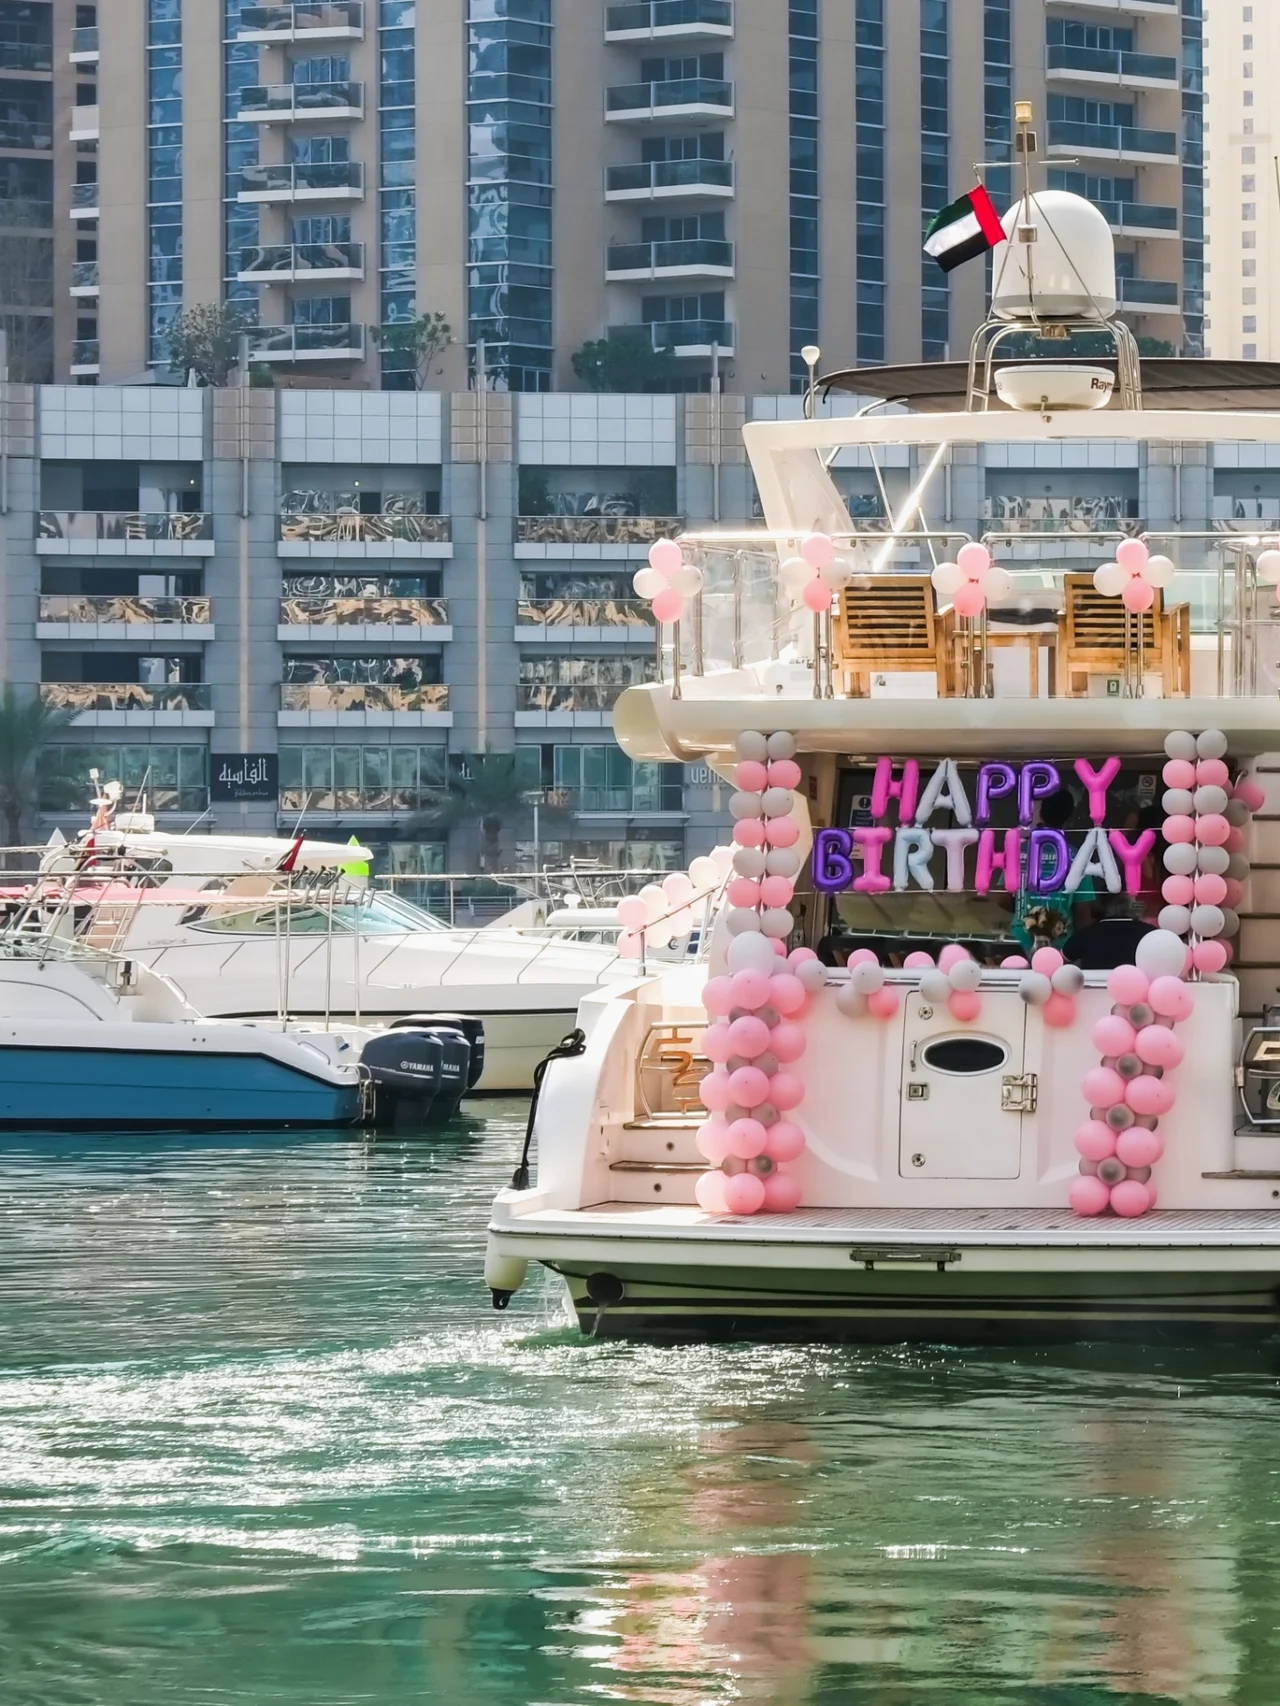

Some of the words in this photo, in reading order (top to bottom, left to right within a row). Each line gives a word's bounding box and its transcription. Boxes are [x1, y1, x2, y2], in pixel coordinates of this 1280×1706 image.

[870, 756, 1122, 827] HAPPY
[811, 827, 1156, 895] BIRTHDAY
[409, 1062, 434, 1072] YAMAHA
[443, 1063, 460, 1072] MAHA
